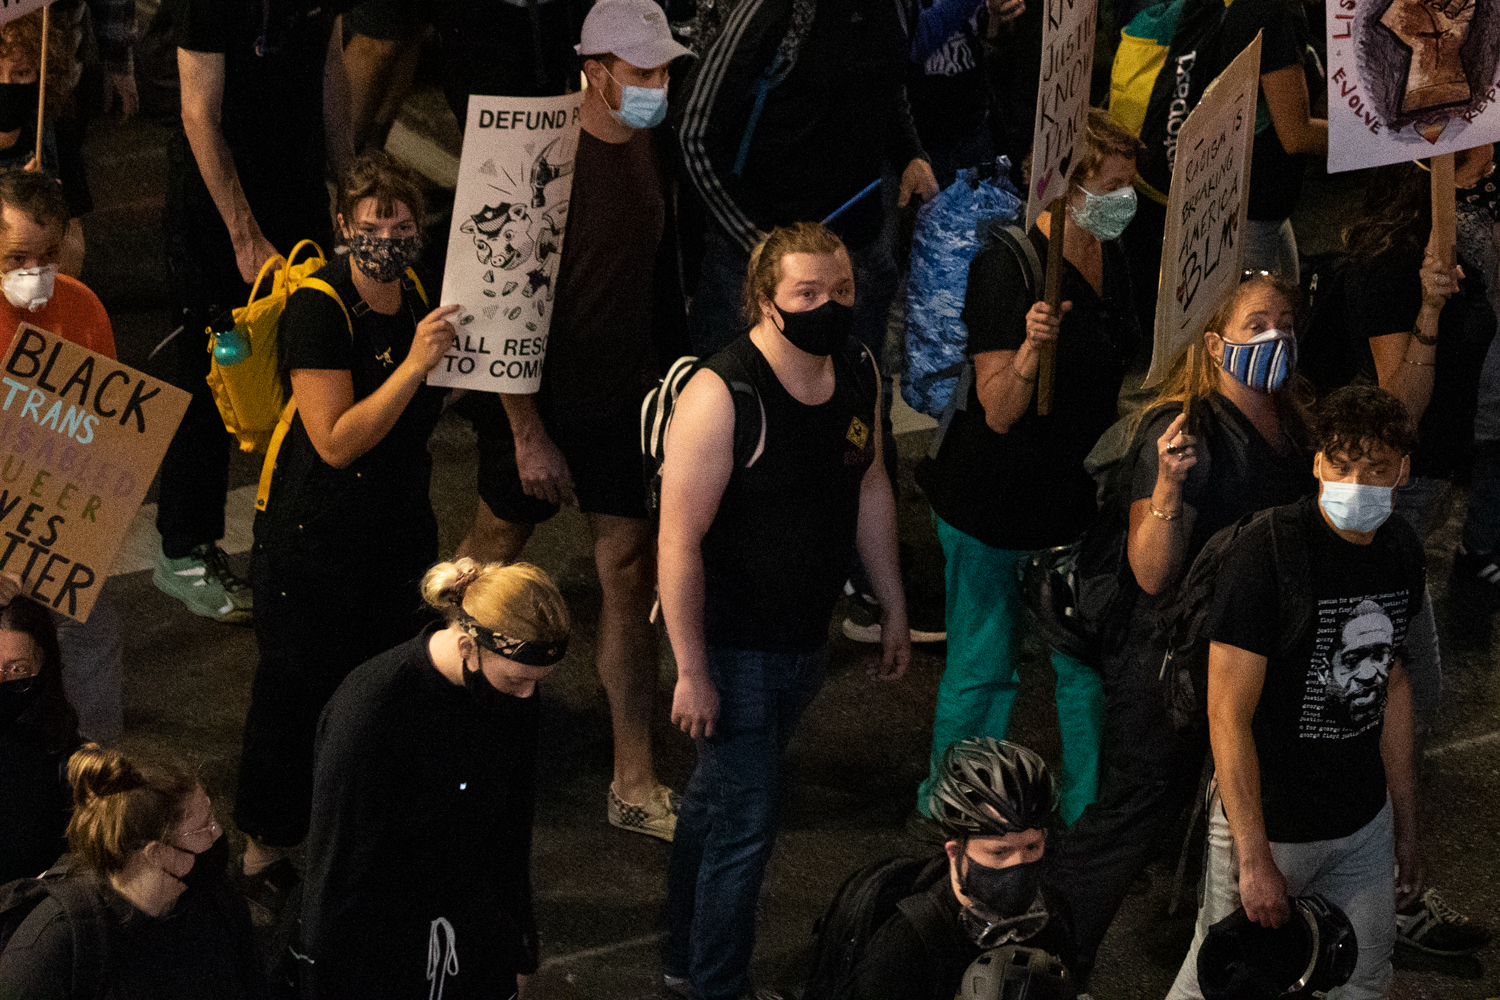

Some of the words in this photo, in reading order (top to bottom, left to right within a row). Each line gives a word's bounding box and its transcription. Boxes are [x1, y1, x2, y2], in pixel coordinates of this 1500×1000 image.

[478, 109, 567, 130] DEFUND
[1331, 66, 1382, 136] EVOLVE
[5, 327, 162, 434] BLACK
[443, 354, 476, 375] TO
[1, 376, 100, 445] TRANS
